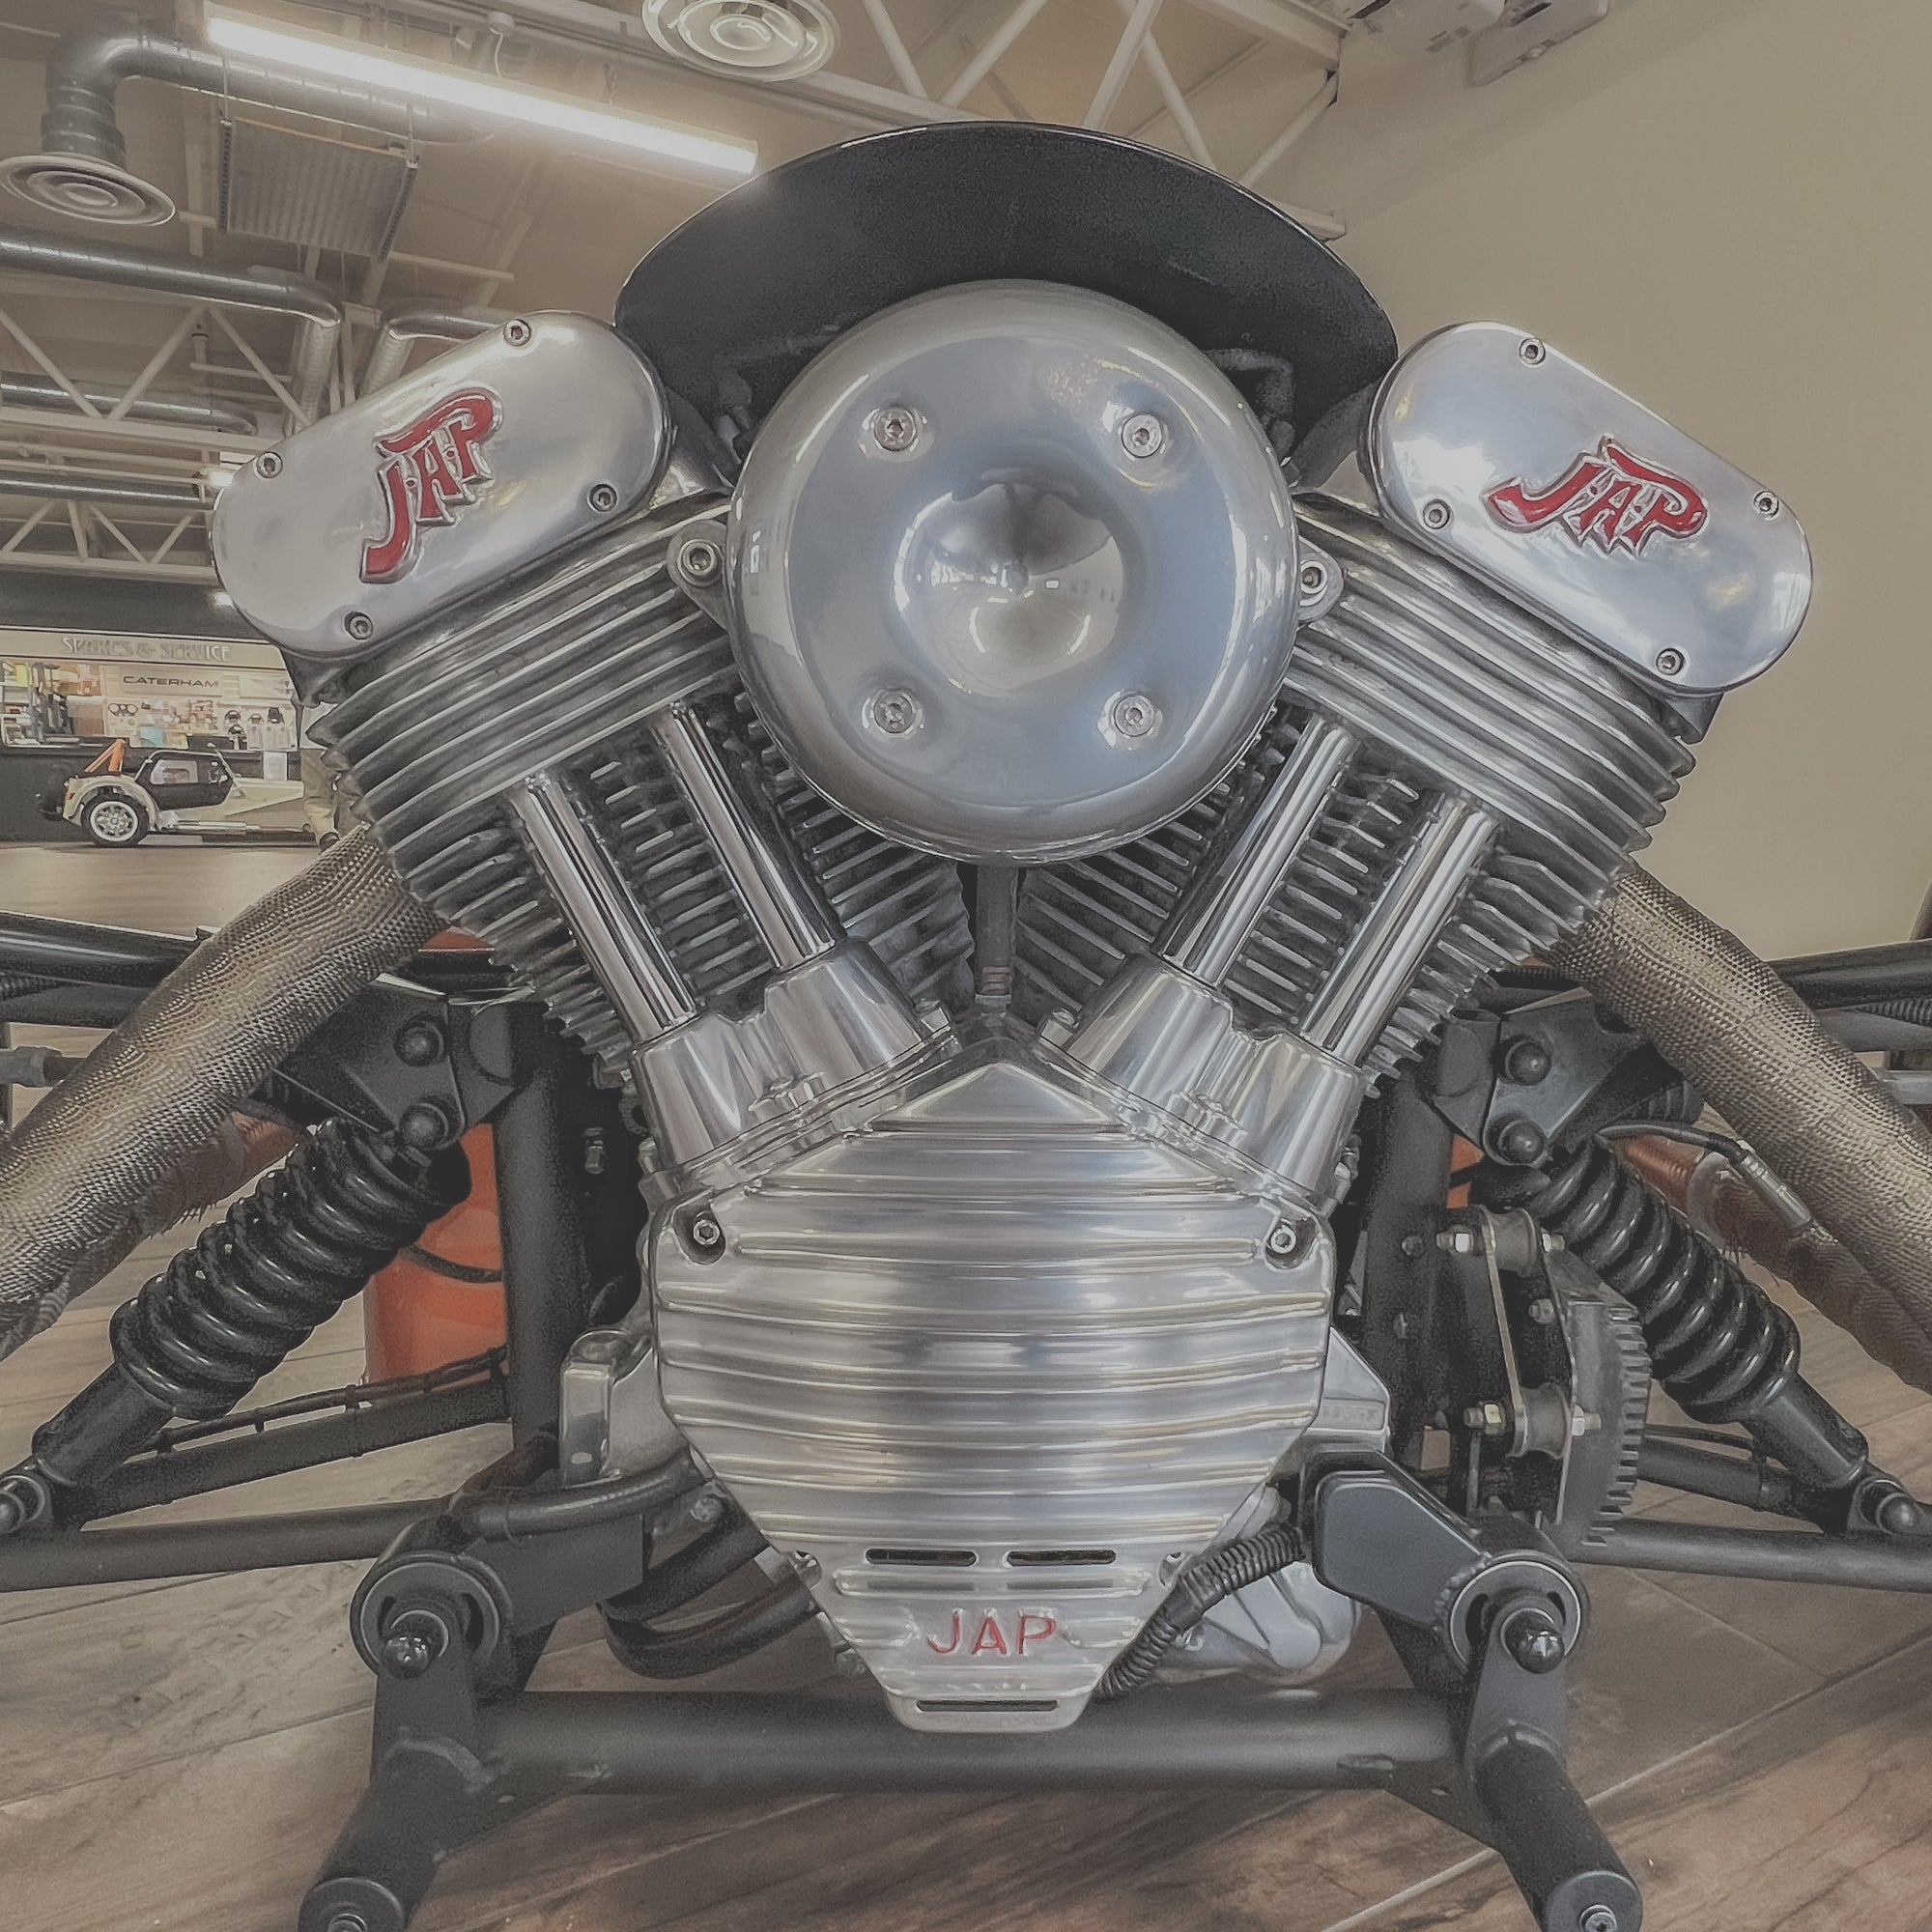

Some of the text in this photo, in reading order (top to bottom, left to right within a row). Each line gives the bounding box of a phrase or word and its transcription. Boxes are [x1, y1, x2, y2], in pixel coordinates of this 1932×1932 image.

[61, 637, 231, 662] SPARES & SERVICE
[123, 675, 218, 688] CATERHAM
[926, 1609, 1058, 1655] JAP
